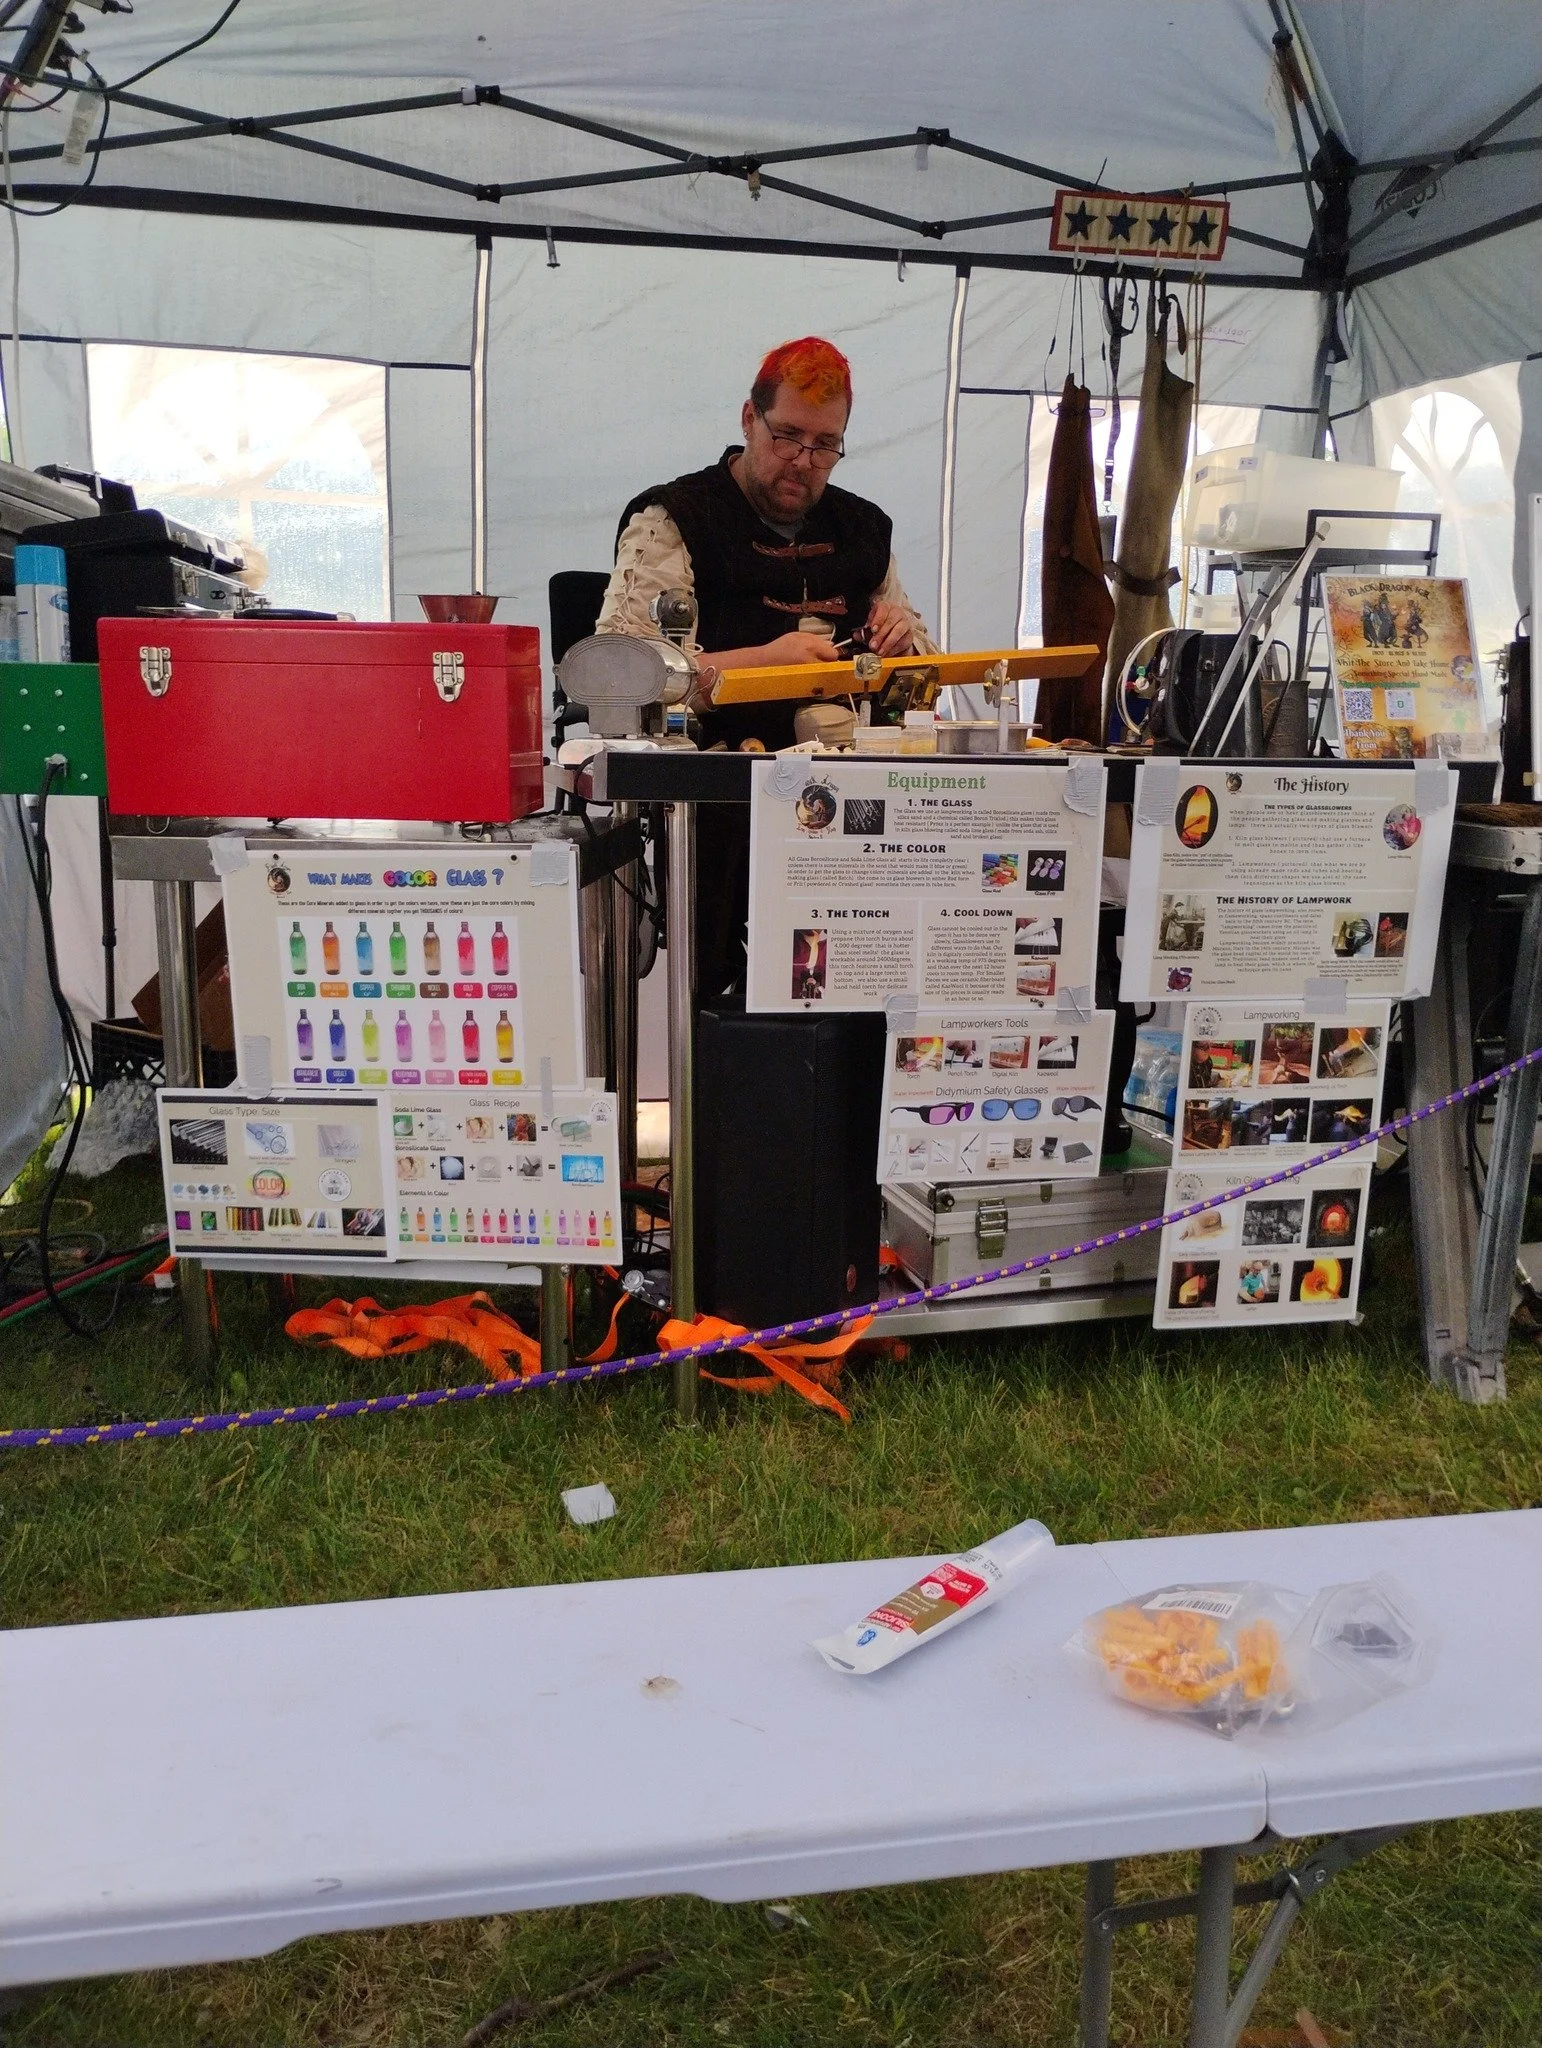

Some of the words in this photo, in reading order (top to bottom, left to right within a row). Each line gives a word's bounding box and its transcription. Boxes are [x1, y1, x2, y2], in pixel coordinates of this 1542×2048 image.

[1344, 729, 1368, 738] Thank
[887, 772, 986, 792] Equipment
[1274, 777, 1297, 791] The
[1300, 775, 1349, 795] History
[908, 799, 917, 807] 1.
[920, 799, 939, 807] THE
[863, 843, 876, 853] 2.
[880, 844, 903, 853] THE
[906, 844, 946, 854] COLOR
[307, 872, 337, 886] WHAT
[341, 872, 372, 886] MAKES
[383, 870, 437, 887] COLOR
[446, 869, 487, 886] GLASS
[492, 869, 504, 886] ?
[811, 909, 823, 918] 3.
[827, 909, 848, 918] THE
[852, 909, 890, 918] TORCH
[940, 909, 950, 918] 4.
[954, 909, 979, 918] COOL
[983, 909, 1013, 918] DOWN
[1244, 1010, 1300, 1021] Lampworking
[941, 1019, 1002, 1030] Lampworkers
[1005, 1019, 1028, 1027] Tools
[936, 1086, 982, 1098] Didymium
[984, 1086, 1011, 1096] Safety
[1014, 1086, 1048, 1094] Glasses
[494, 1099, 520, 1108] Recipe
[209, 1107, 233, 1115] Glass
